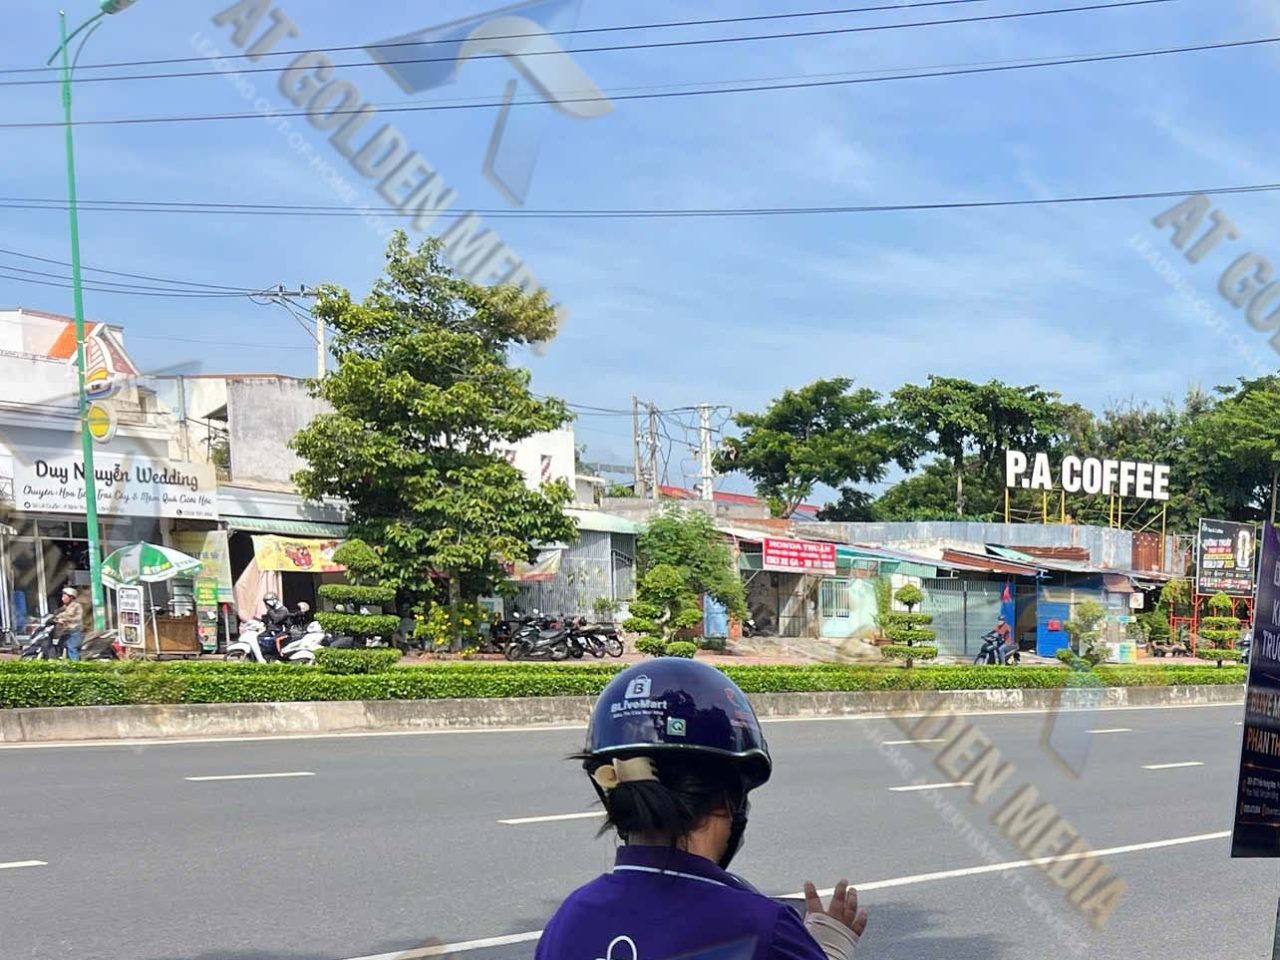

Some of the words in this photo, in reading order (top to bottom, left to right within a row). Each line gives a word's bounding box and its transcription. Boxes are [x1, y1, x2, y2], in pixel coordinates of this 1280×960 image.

[36, 460, 68, 484] Duy
[136, 466, 198, 492] Wedding
[1006, 450, 1052, 490] P.A
[1062, 455, 1171, 500] COFFEE
